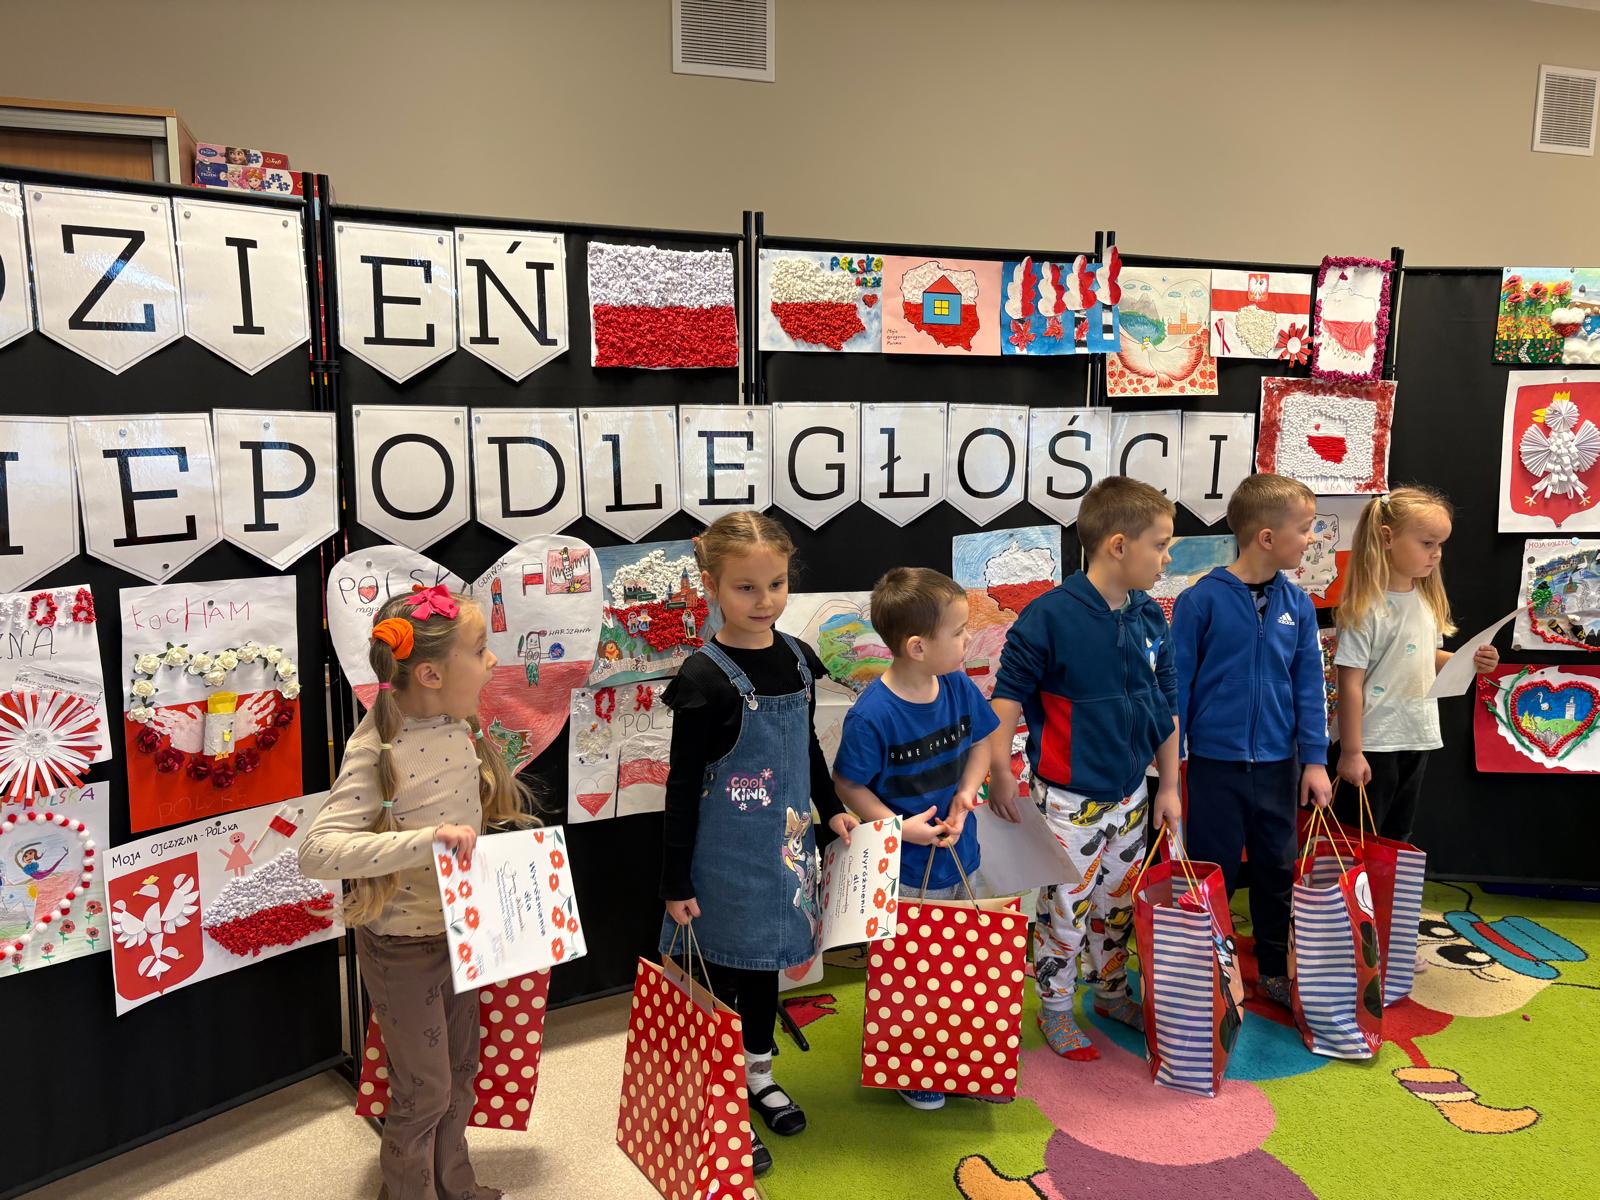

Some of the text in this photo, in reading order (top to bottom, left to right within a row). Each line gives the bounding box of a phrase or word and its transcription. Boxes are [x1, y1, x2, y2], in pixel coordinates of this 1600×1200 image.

[0, 224, 558, 347] ZIEŃ
[477, 558, 508, 588] GDAŃSK
[131, 597, 250, 632] KOCHAM
[0, 627, 58, 660] NA
[890, 748, 921, 760] GAME
[731, 776, 766, 788] COOL
[731, 787, 768, 801] KIND
[112, 852, 142, 868] MOJA
